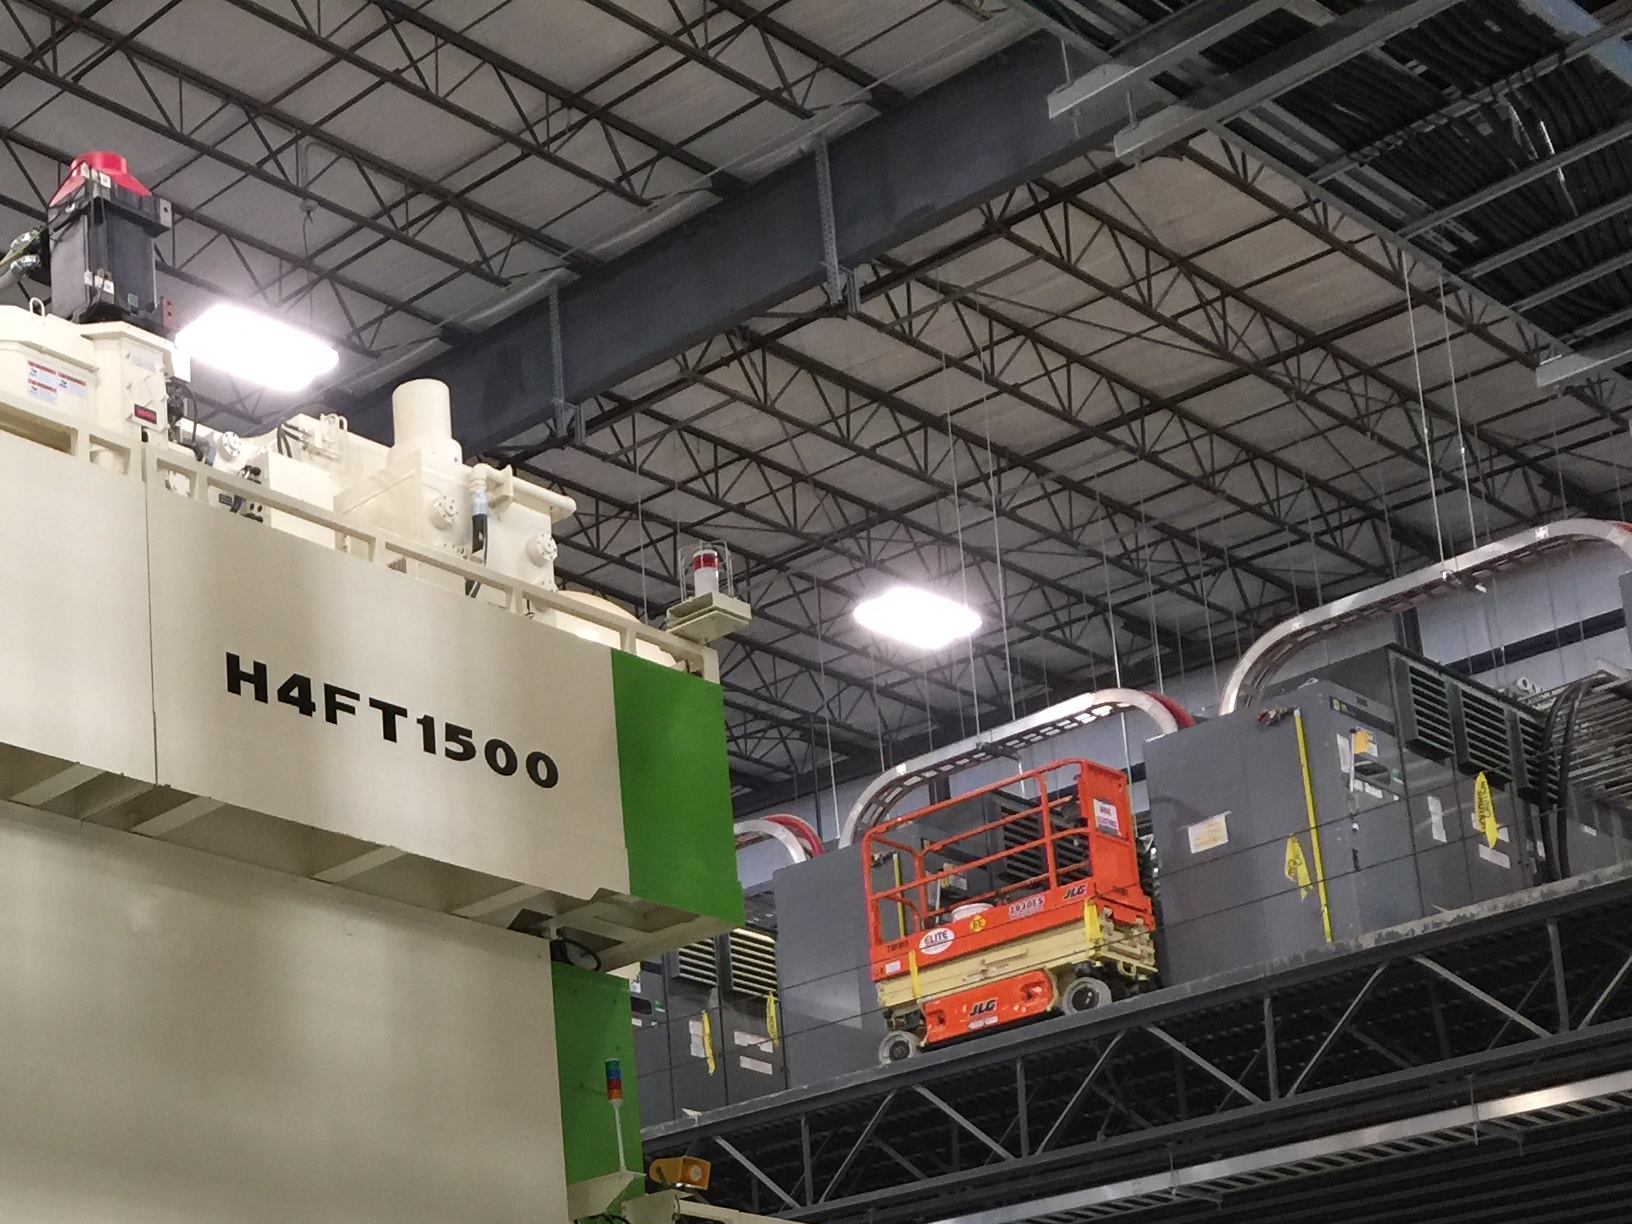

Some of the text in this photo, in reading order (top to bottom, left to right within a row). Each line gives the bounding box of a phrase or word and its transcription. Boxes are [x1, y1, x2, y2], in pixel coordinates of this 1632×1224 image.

[225, 651, 559, 789] H4FT1500
[1064, 885, 1086, 899] JLG
[924, 930, 949, 945] ELITE
[969, 999, 996, 1016] JLG
